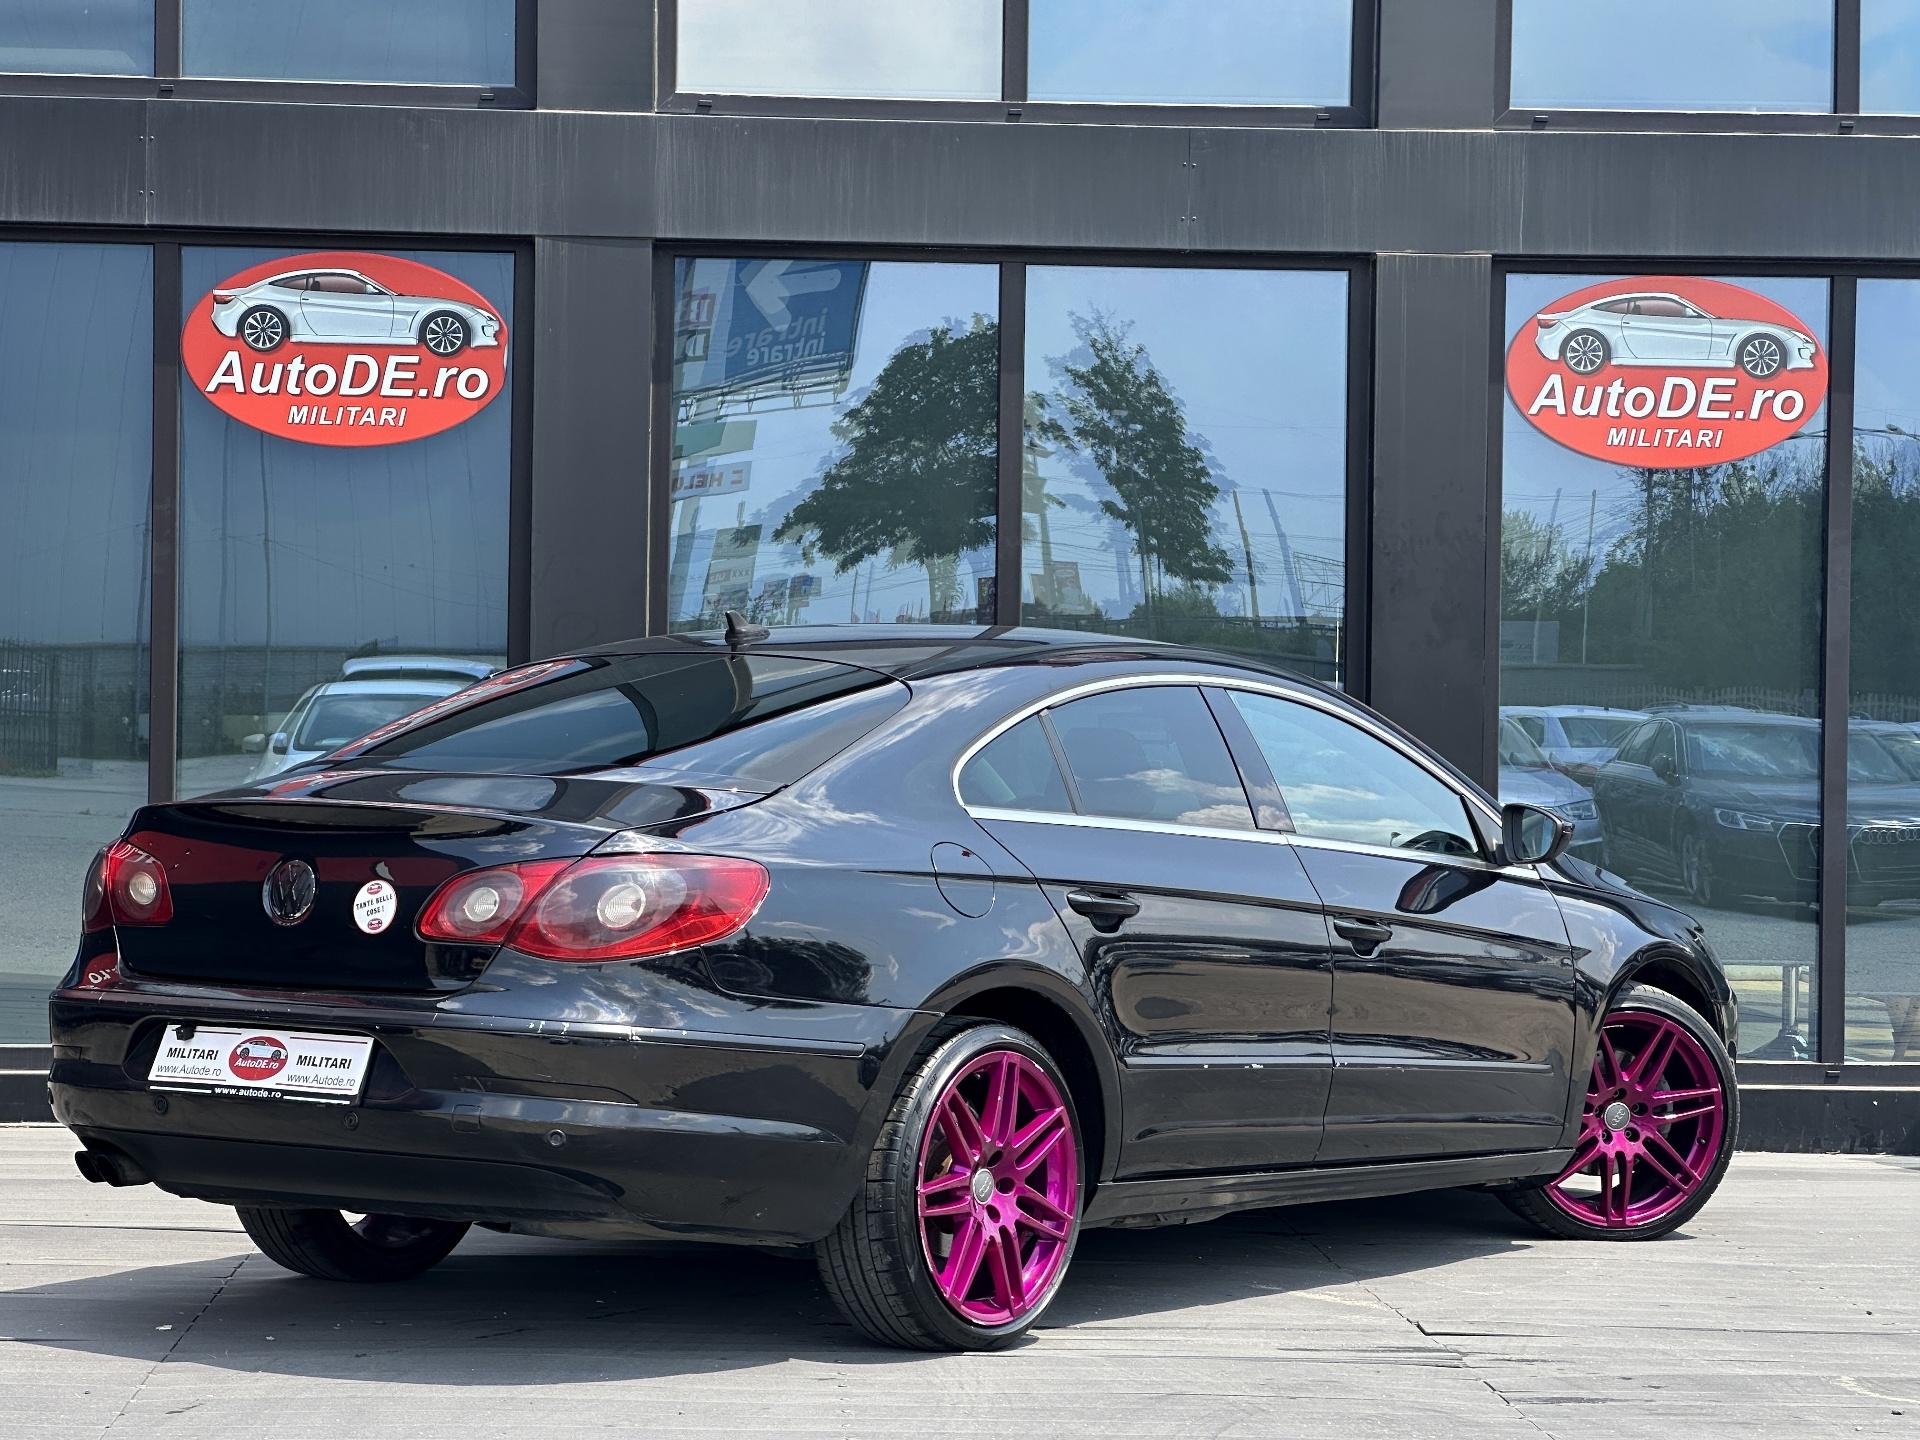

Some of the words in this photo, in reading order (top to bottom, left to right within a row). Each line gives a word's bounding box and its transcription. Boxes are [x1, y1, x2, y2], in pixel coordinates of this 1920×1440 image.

[205, 350, 489, 399] AutoDE.ro
[1528, 373, 1804, 422] AutoDE.ro
[287, 405, 407, 427] MILITARI
[1606, 427, 1723, 448] MILITARI
[355, 899, 375, 911] TANTE
[166, 1047, 219, 1061] MILITARI
[234, 1058, 279, 1069] AutoDE.ro
[296, 1054, 352, 1070] MILITARI
[157, 1064, 222, 1077] www.Autode.ro
[287, 1073, 356, 1087] www.Autode.ro
[214, 1087, 282, 1099] www.autode.ro
